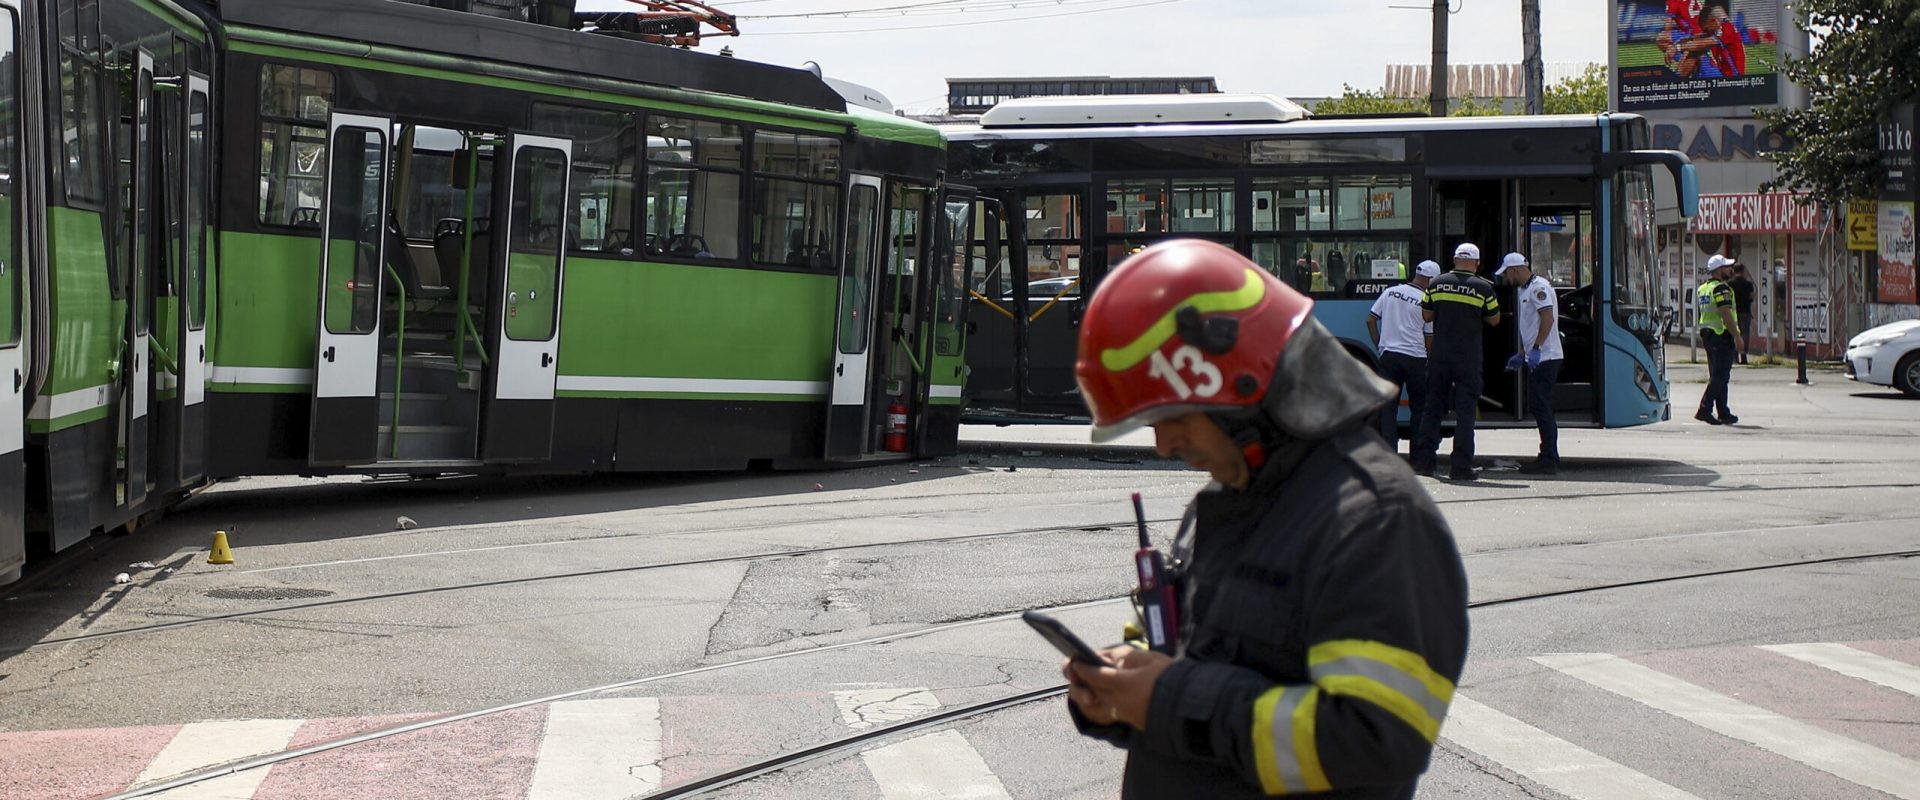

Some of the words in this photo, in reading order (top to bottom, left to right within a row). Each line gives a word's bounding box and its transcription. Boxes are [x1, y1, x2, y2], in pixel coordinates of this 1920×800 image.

[1879, 122, 1911, 150] hiko
[1698, 197, 1738, 230] SERVICE
[1740, 196, 1761, 230] GSM
[1765, 195, 1772, 230] &
[1775, 195, 1817, 230] LAPTOP
[1355, 284, 1388, 294] KENT
[1436, 283, 1476, 296] POLITIA
[1148, 345, 1223, 400] 13
